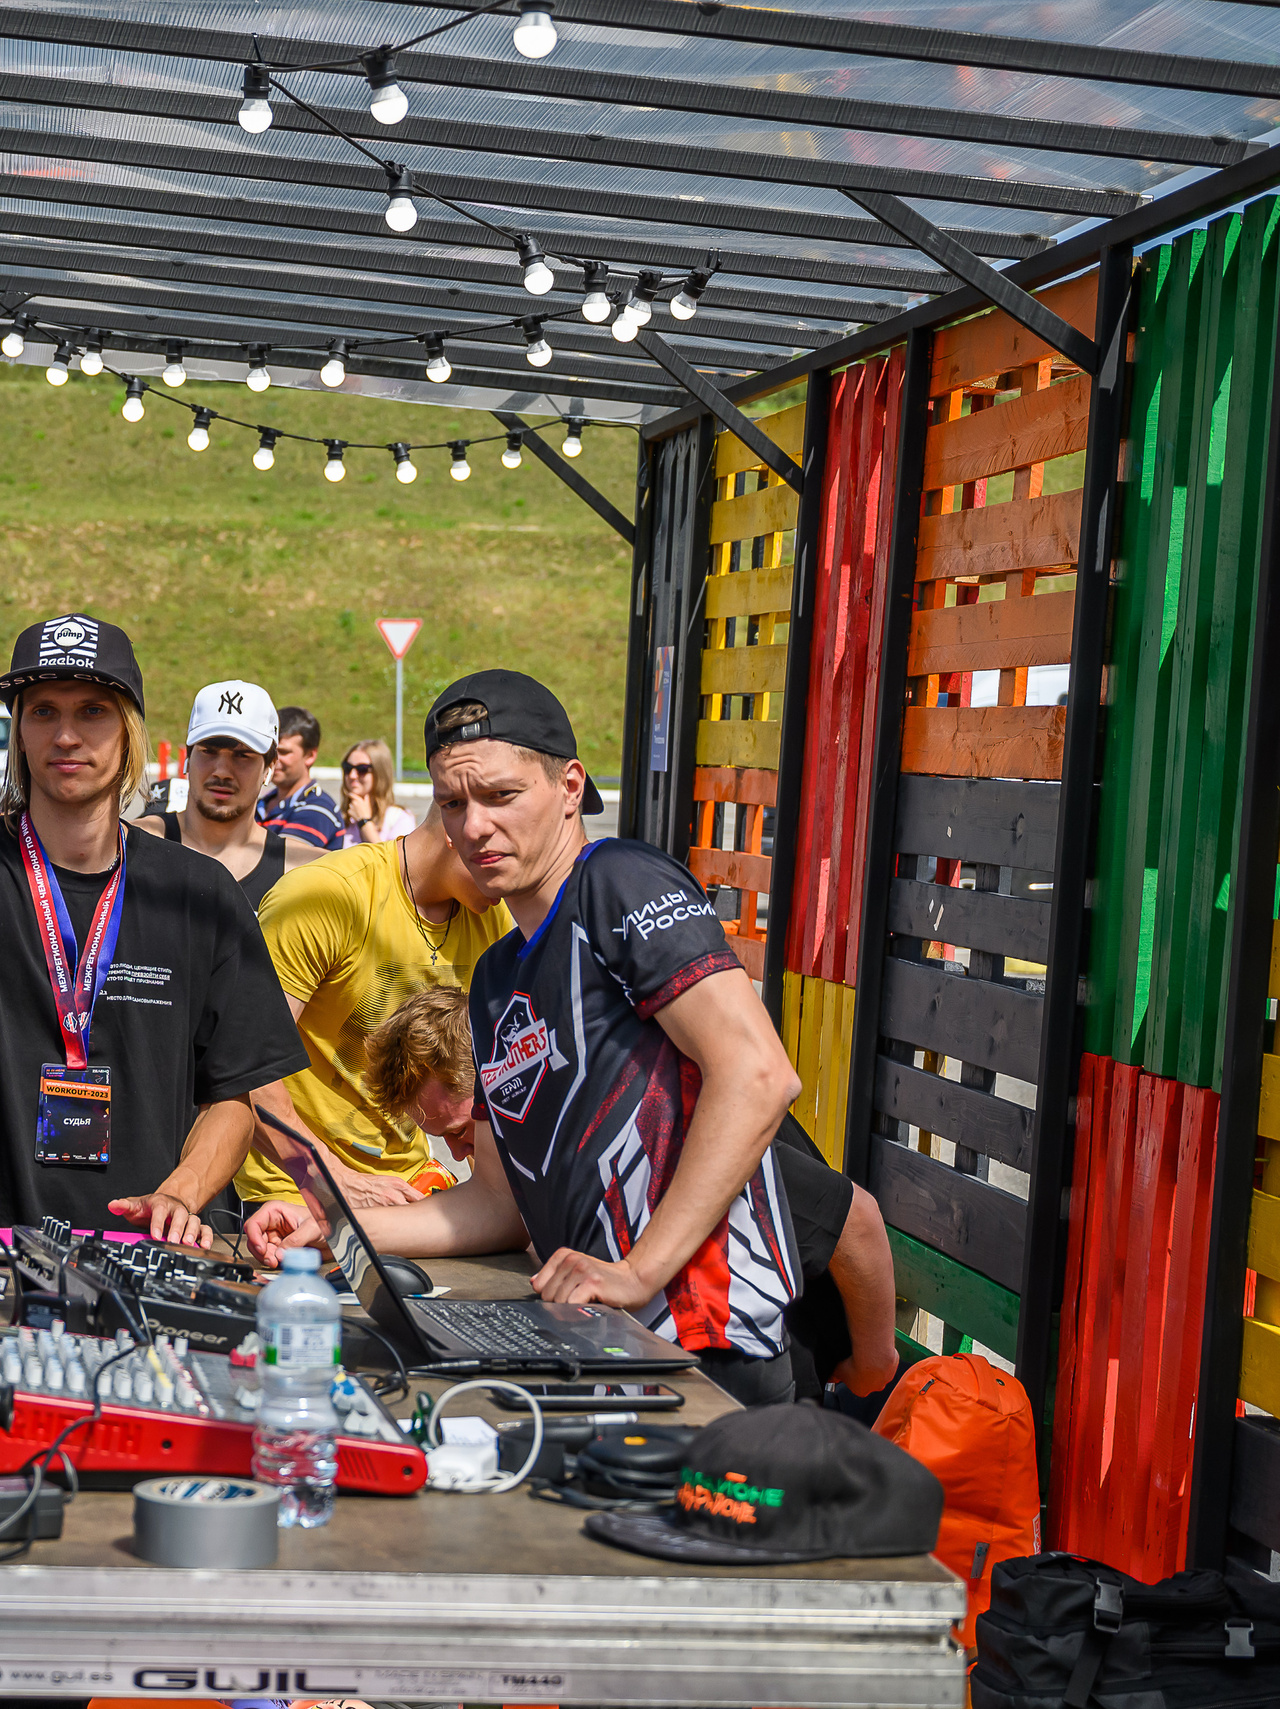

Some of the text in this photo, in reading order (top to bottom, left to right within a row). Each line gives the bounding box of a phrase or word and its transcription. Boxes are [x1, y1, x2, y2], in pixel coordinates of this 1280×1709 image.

[56, 629, 83, 640] pump
[218, 690, 244, 715] NY
[24, 834, 34, 850] ПО
[28, 849, 48, 899] ЧЕМПИОНАТ
[39, 898, 68, 993] МЕЖРЕГИОНАЛЬНЫЙ
[82, 898, 111, 992] МЕЖРЕГИОНАЛЬНЫЙ
[46, 1086, 109, 1098] WORKOUT-2023
[63, 1118, 91, 1126] СУДЬЯ
[140, 1317, 229, 1345] Pioneer
